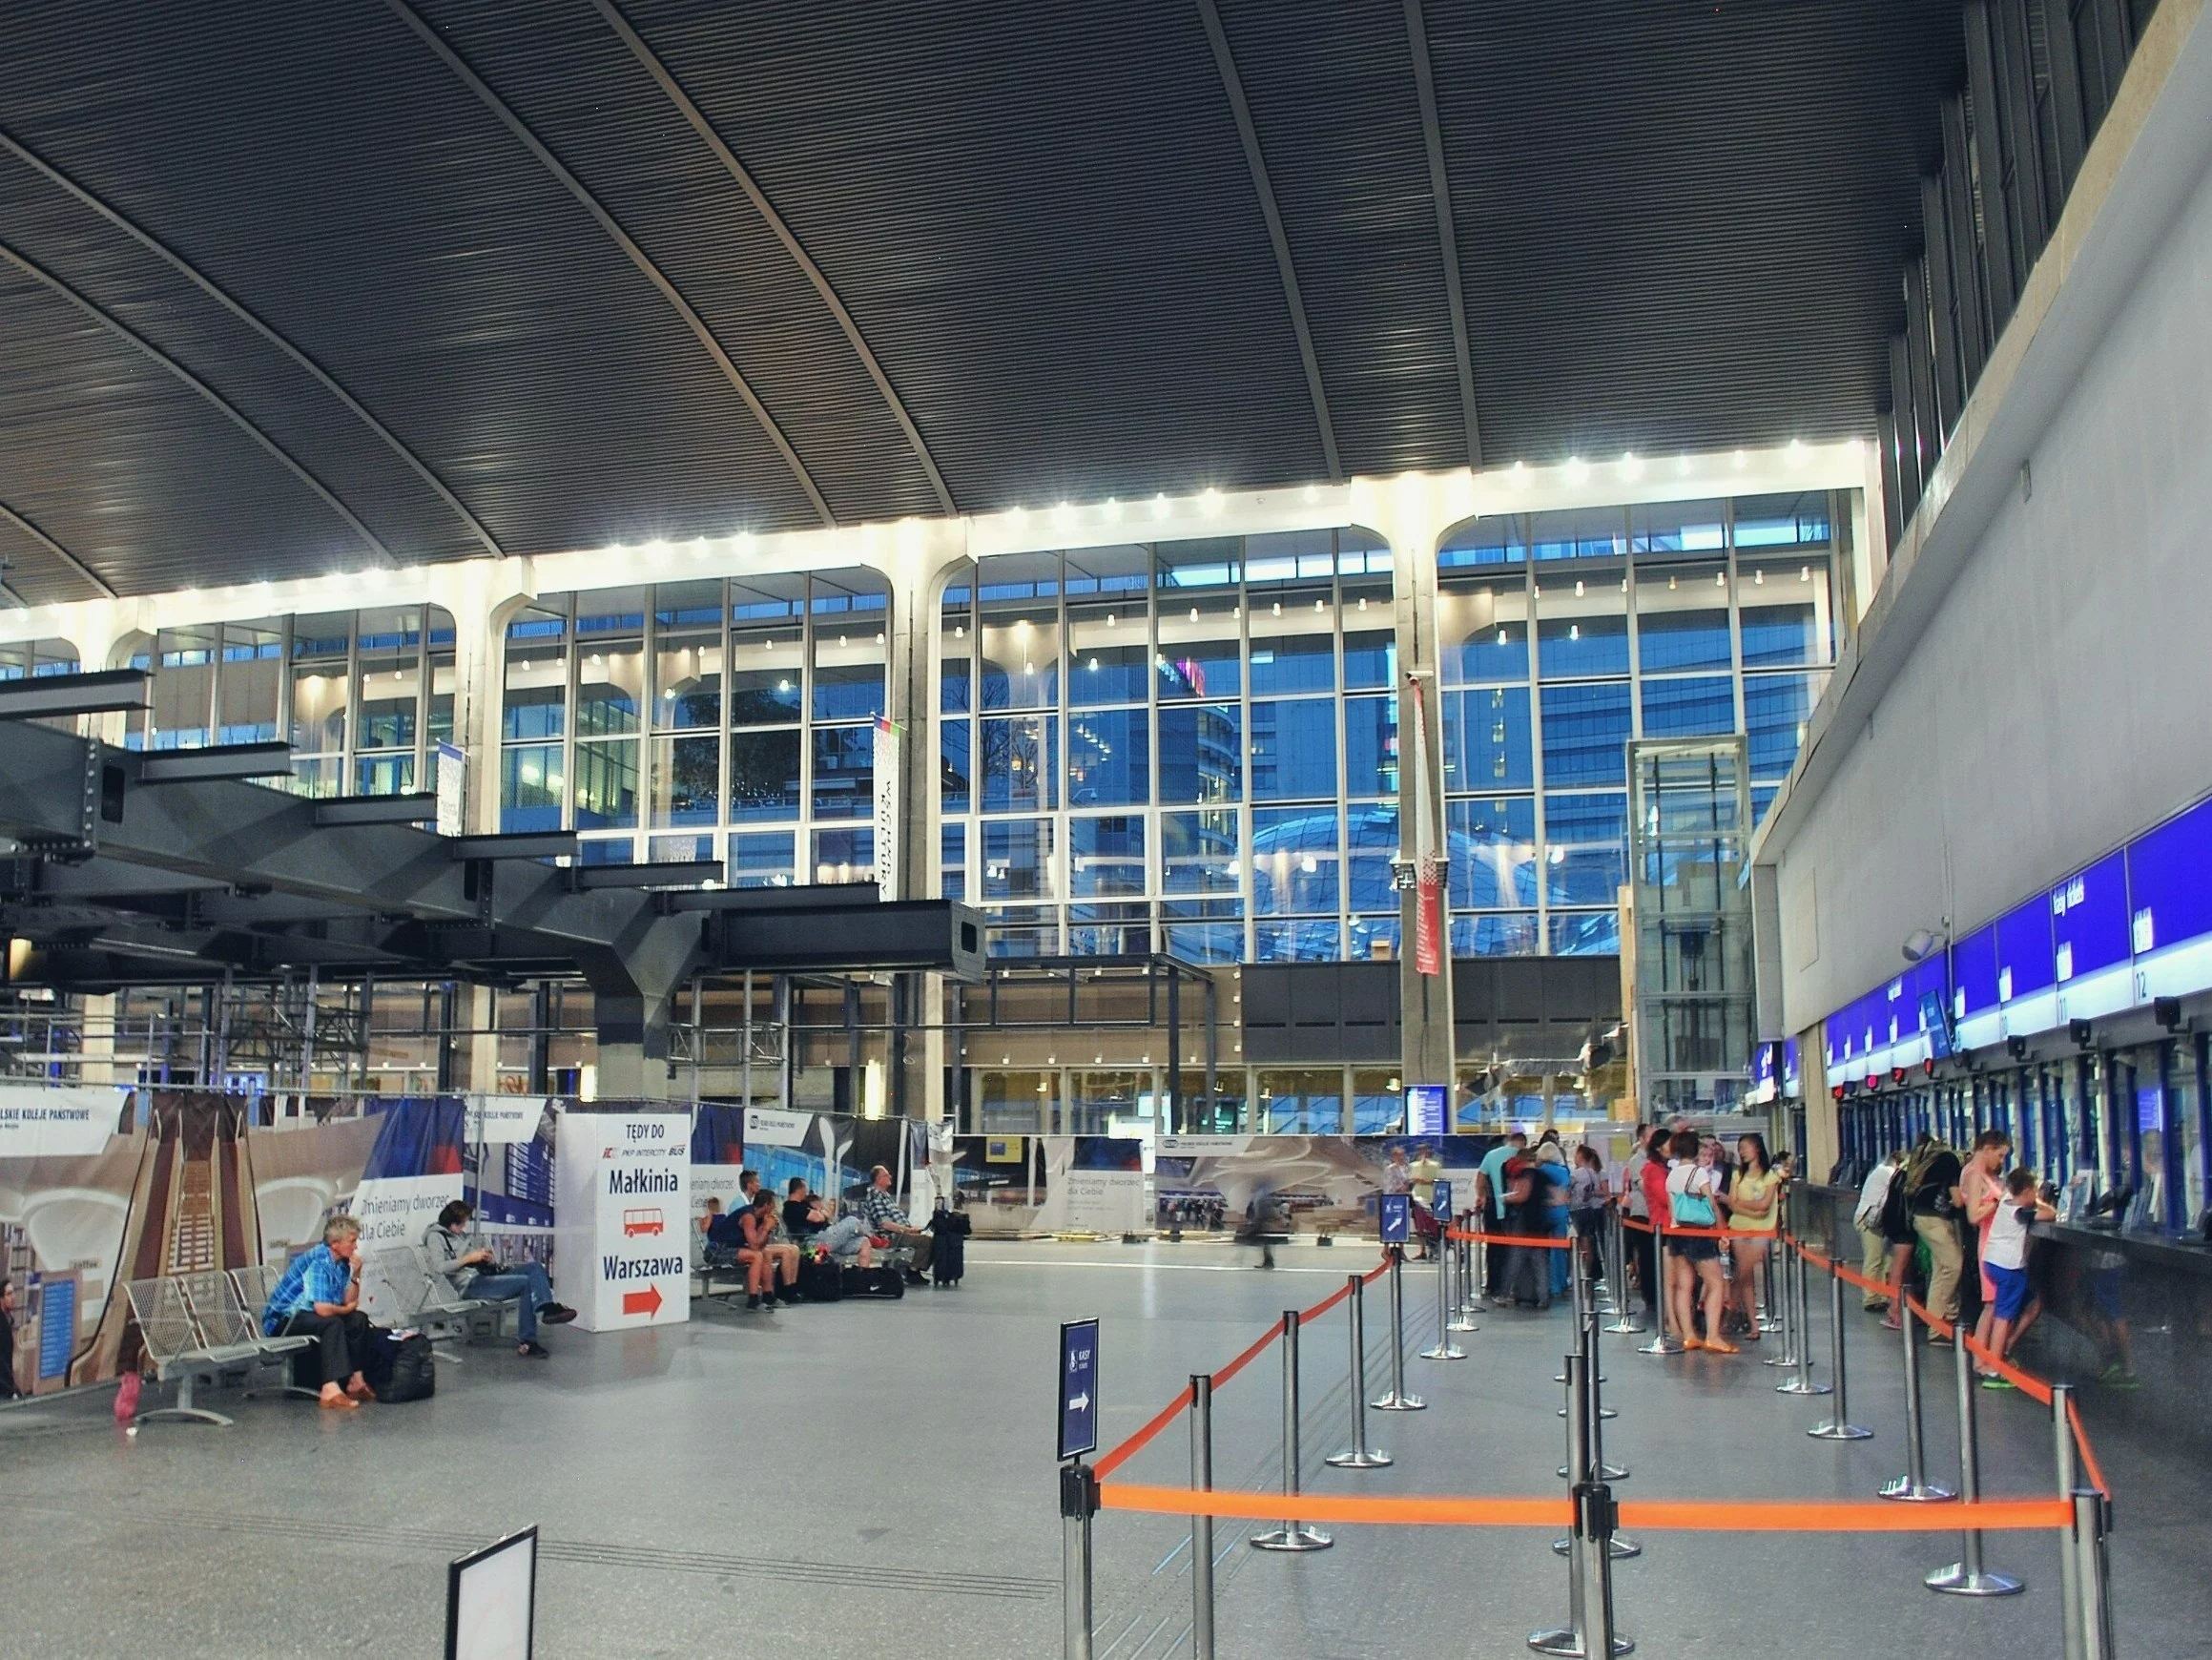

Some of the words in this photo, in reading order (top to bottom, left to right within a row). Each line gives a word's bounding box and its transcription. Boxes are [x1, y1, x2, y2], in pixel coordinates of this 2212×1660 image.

[2136, 971, 2147, 1000] 12
[21, 1108, 47, 1120] KOLEJE
[49, 1106, 90, 1120] PAŃSTWOWE
[626, 1124, 650, 1143] TĘDY
[651, 1124, 665, 1139] DO
[622, 1149, 635, 1157] PKP
[635, 1149, 667, 1157] INTERCITY
[669, 1147, 686, 1157] BUS
[609, 1168, 678, 1194] Małkinia
[376, 1219, 405, 1239] Ciebie
[603, 1255, 683, 1281] Warszawa
